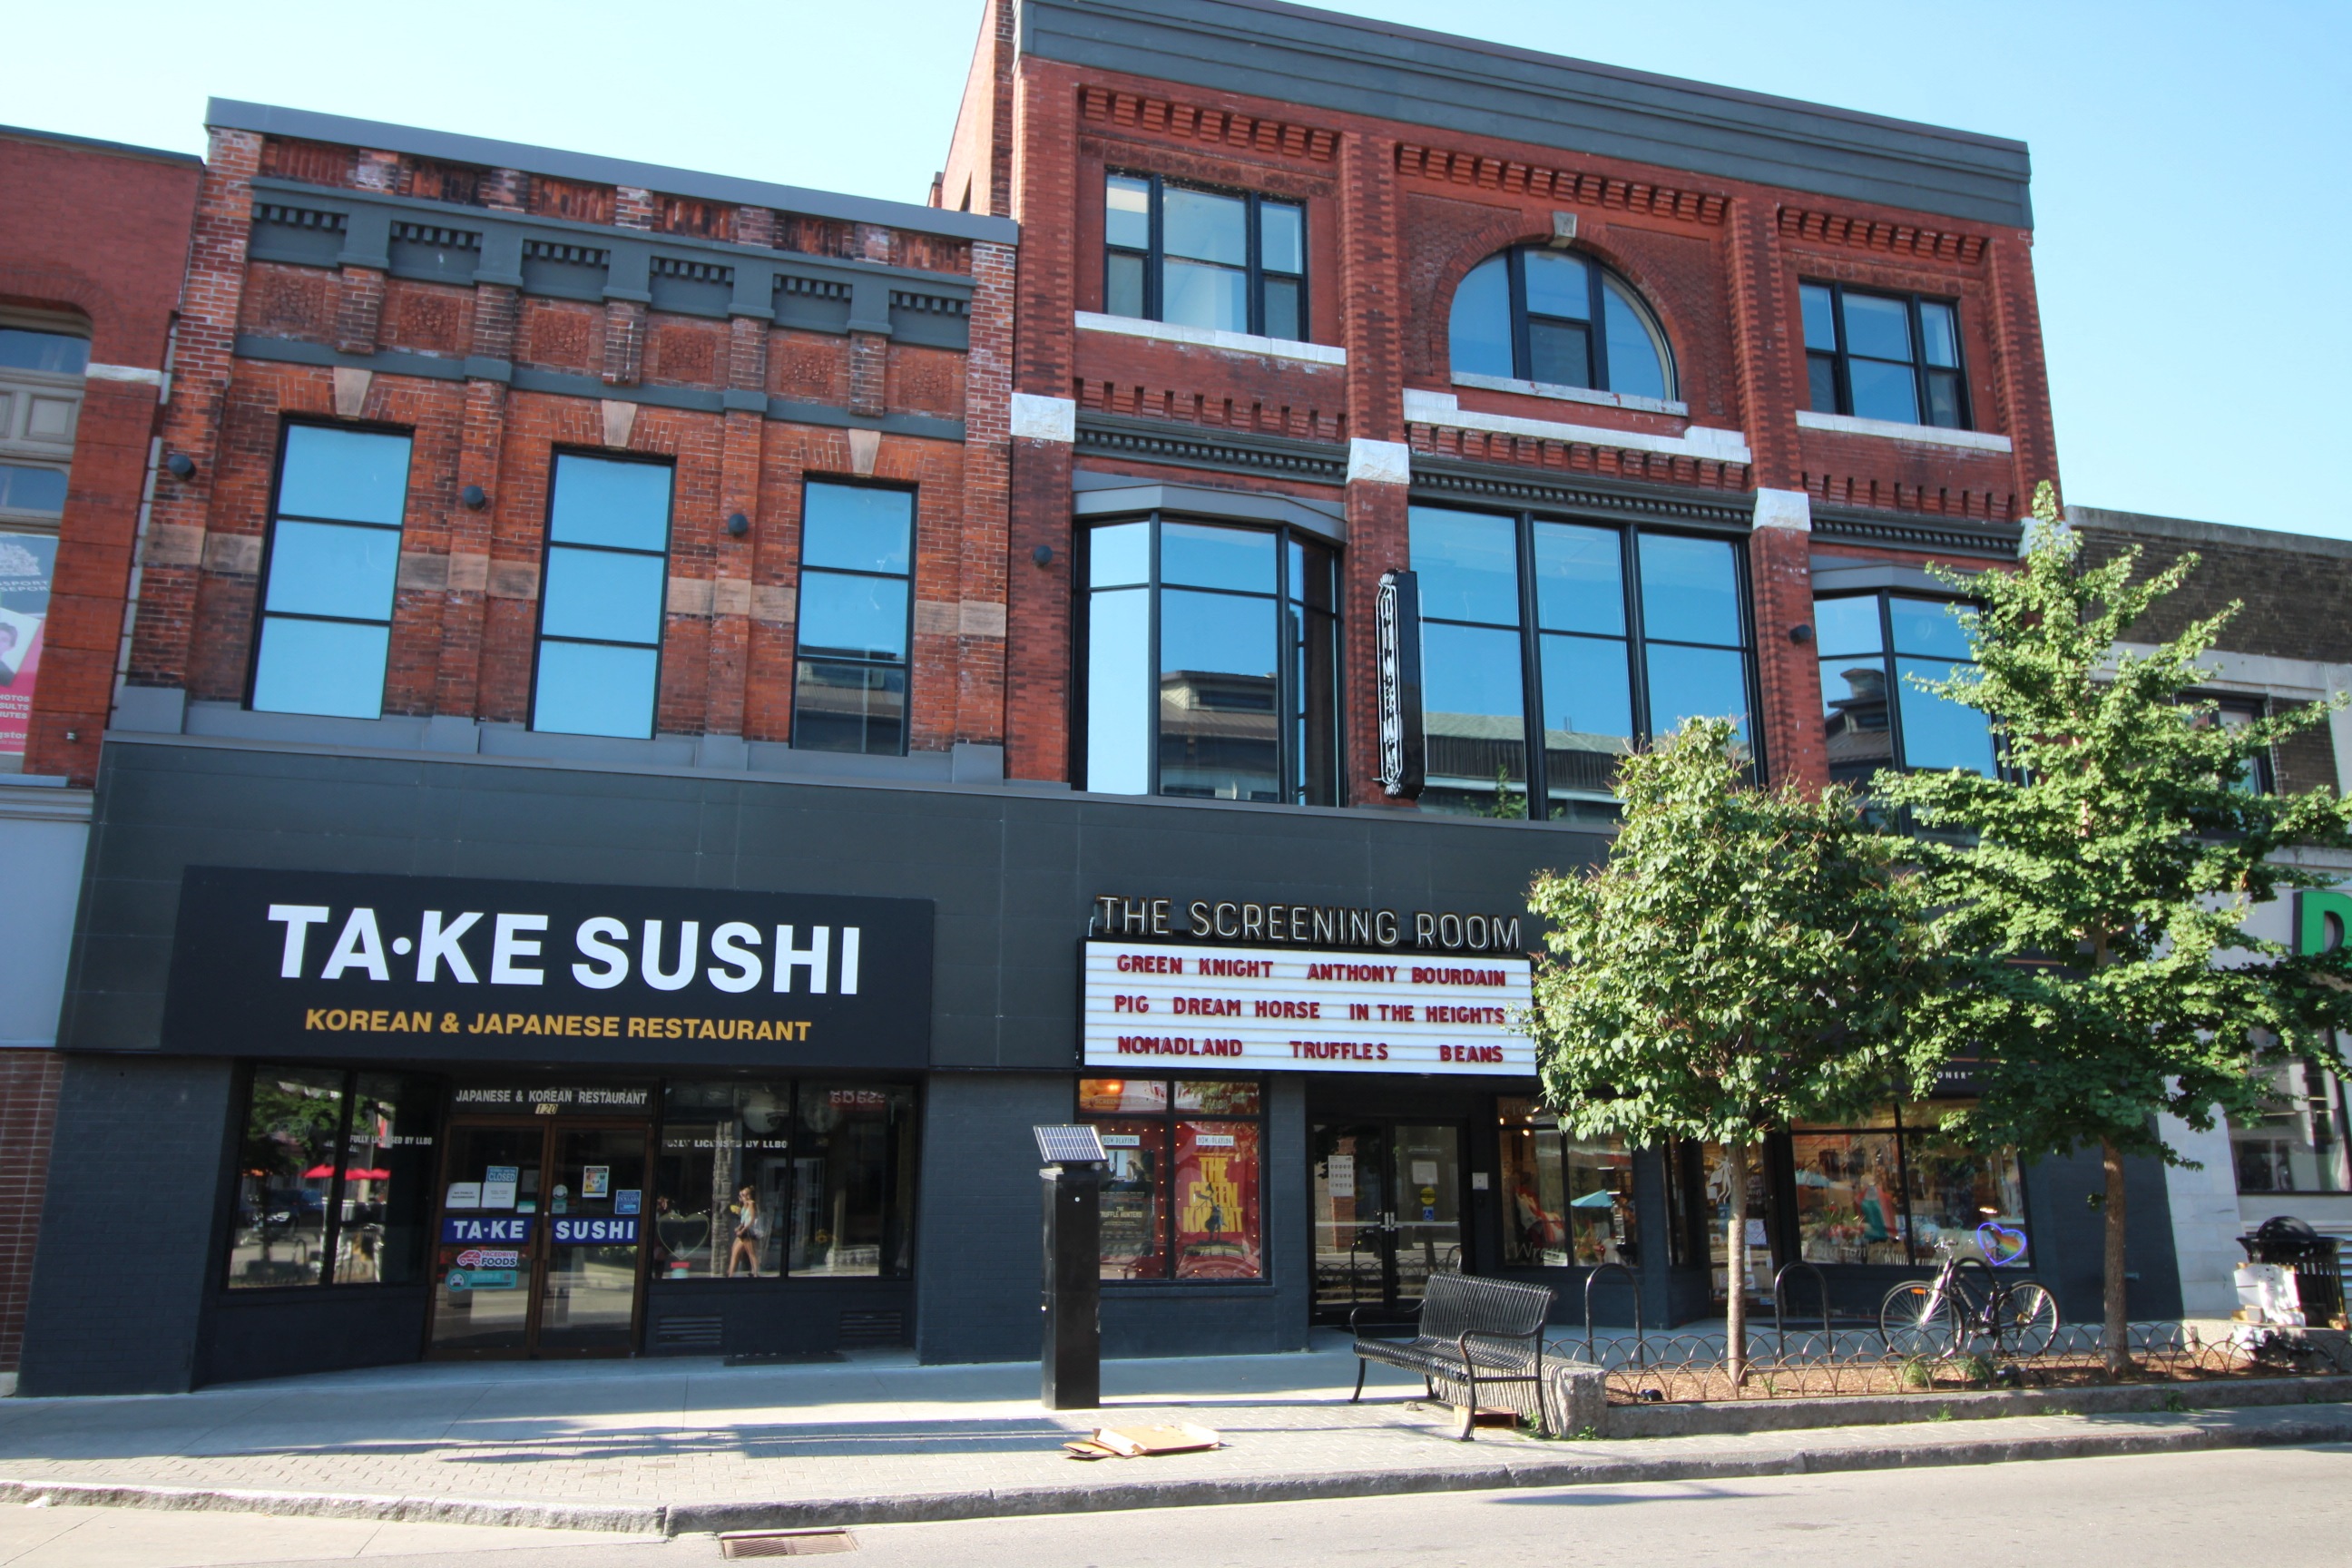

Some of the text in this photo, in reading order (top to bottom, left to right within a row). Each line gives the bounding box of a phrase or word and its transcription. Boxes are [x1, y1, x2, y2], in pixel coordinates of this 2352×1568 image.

[1096, 894, 1522, 952] THE SCREENING ROOM
[572, 916, 860, 995] SUSHI
[1116, 955, 1506, 986] GREEN KNIGHT ANTHONY BOURDAIN
[1113, 995, 1506, 1024] PIG DREAM HORSE IN THE HEIGHTS
[305, 1008, 812, 1043] KOREAN & JAPANESE RESTAURANT
[1117, 1035, 1504, 1063] NOMADLAND TRUFFLES BEANS
[456, 1089, 648, 1105] JAPANESE & KOREAN RESTAURANT
[537, 1103, 557, 1114] 120
[349, 1134, 369, 1144] FULLY
[404, 1136, 415, 1145] BY
[416, 1136, 433, 1146] LLBO
[745, 1140, 760, 1149] BY
[762, 1140, 788, 1149] LLBO
[488, 1172, 515, 1182] CLOSED
[1198, 1157, 1229, 1181] THE
[554, 1220, 634, 1240] SUSHI
[1182, 1207, 1243, 1233] KNHT
[481, 1257, 516, 1266] FOODS
